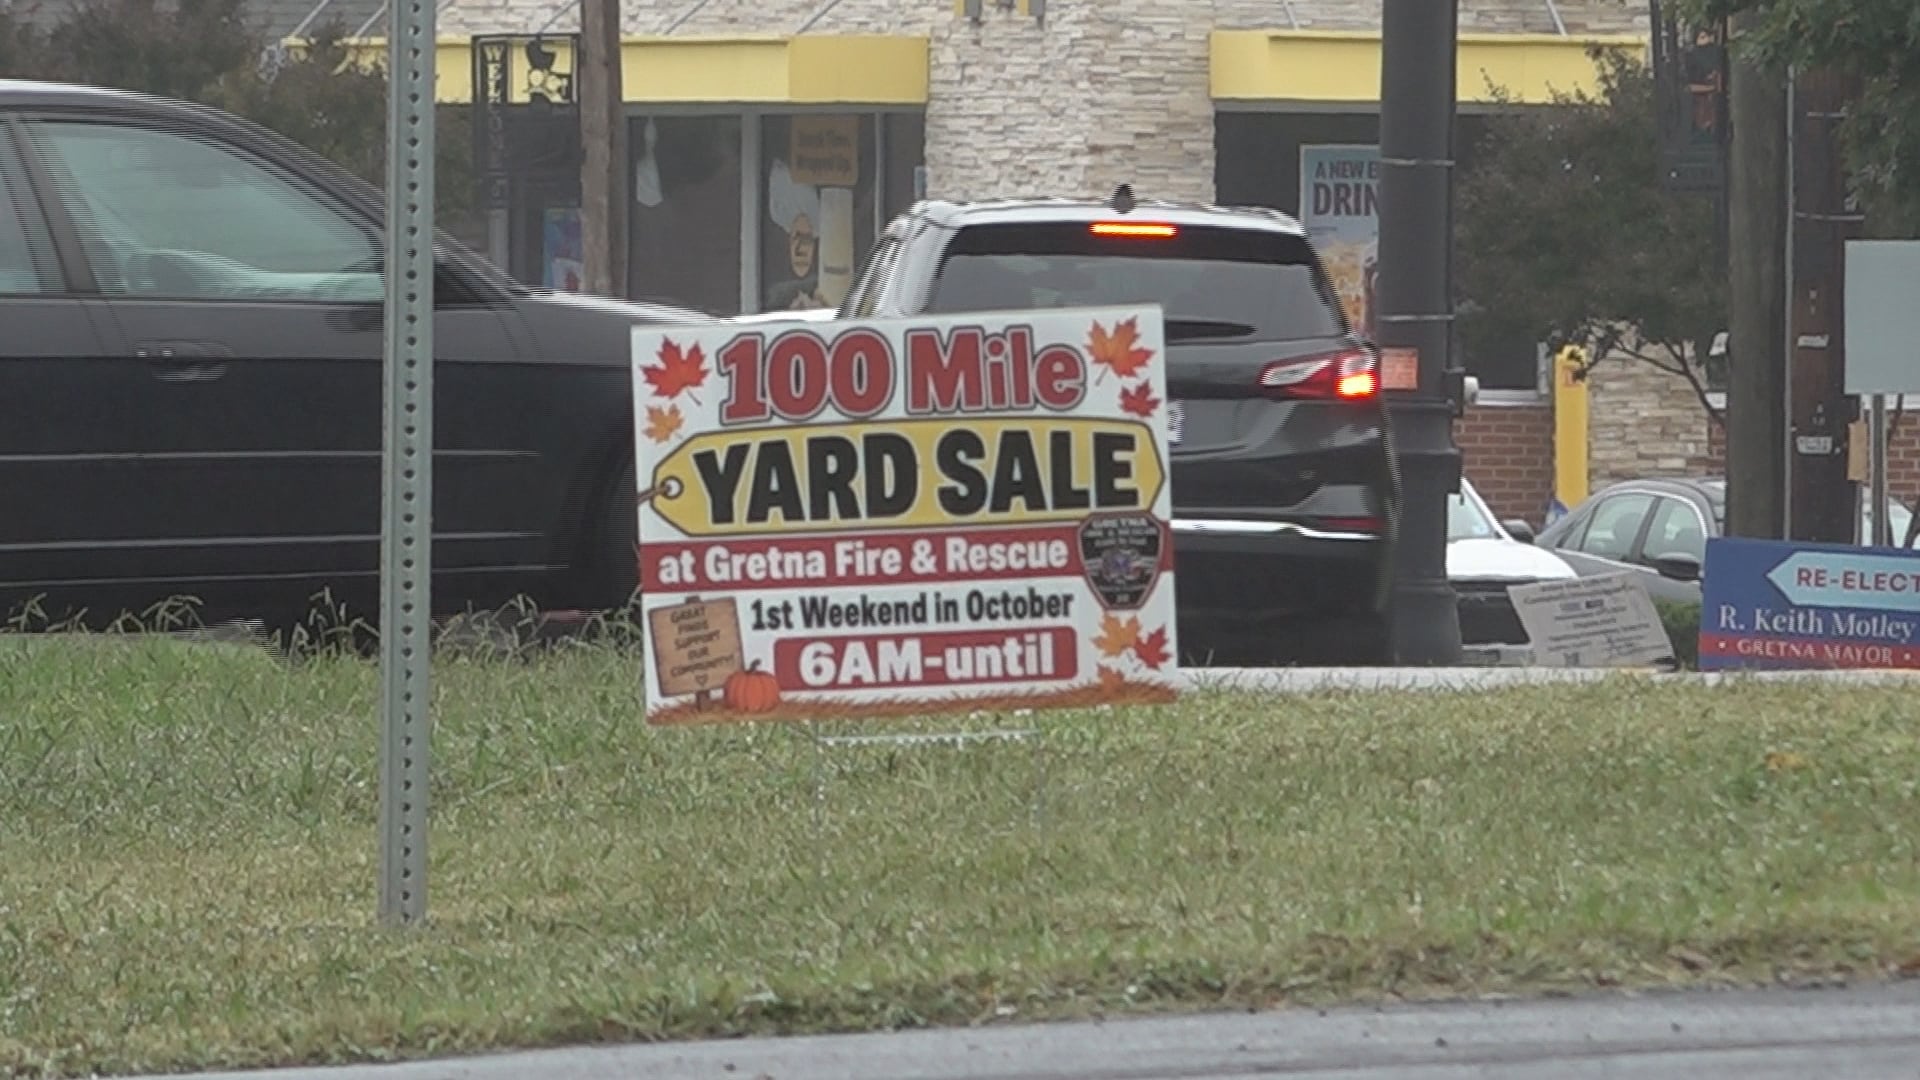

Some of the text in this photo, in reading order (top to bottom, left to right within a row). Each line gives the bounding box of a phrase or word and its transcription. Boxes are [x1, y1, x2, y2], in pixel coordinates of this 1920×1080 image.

[1315, 160, 1377, 178] A NEW E
[1313, 183, 1380, 216] DRIN
[718, 325, 1085, 425] 100 Mile
[693, 429, 1139, 525] YARD SALE
[658, 537, 1068, 584] at Gretna Fire & Rescue
[1796, 567, 1920, 593] RE-ELECT
[751, 588, 1074, 631] 1st Weekend in October
[1719, 604, 1915, 644] R. Keith Motley
[799, 640, 1054, 687] 6AM-until
[1737, 638, 1893, 666] GRETNA MAYOR
